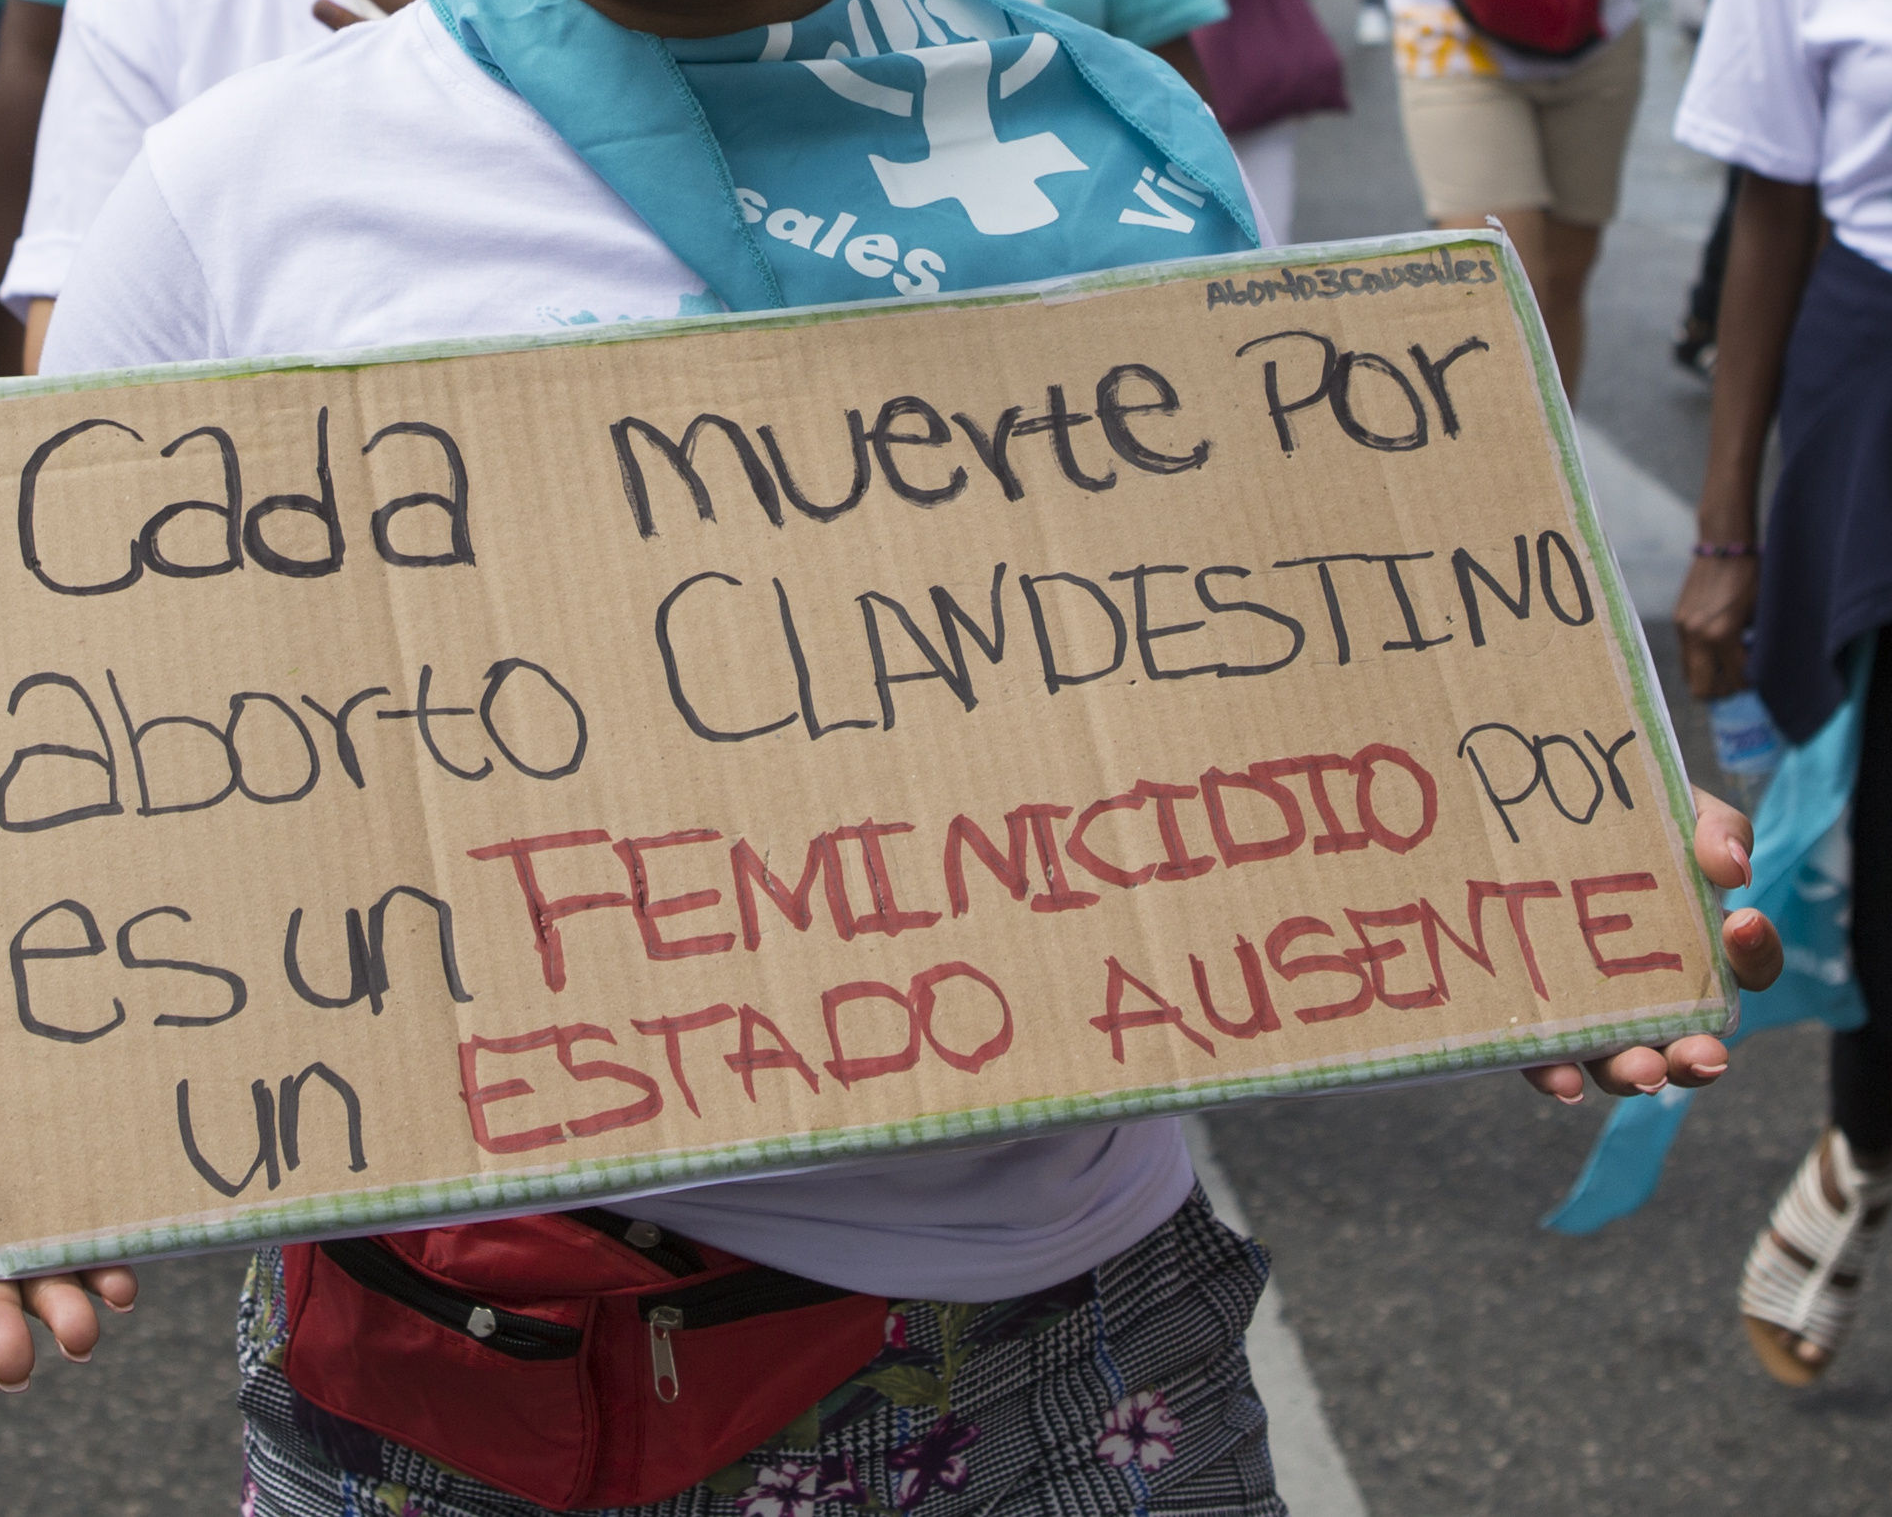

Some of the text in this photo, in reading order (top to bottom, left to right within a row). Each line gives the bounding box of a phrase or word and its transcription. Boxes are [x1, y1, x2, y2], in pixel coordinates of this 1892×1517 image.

[18, 406, 477, 596] Cada
[654, 528, 1594, 742] CLANDESTINO
[9, 899, 249, 1044] es
[283, 885, 475, 1015] un
[466, 742, 1438, 993] FEMINICIDIO
[176, 871, 1685, 1198] un ESTADO AUSENTE
